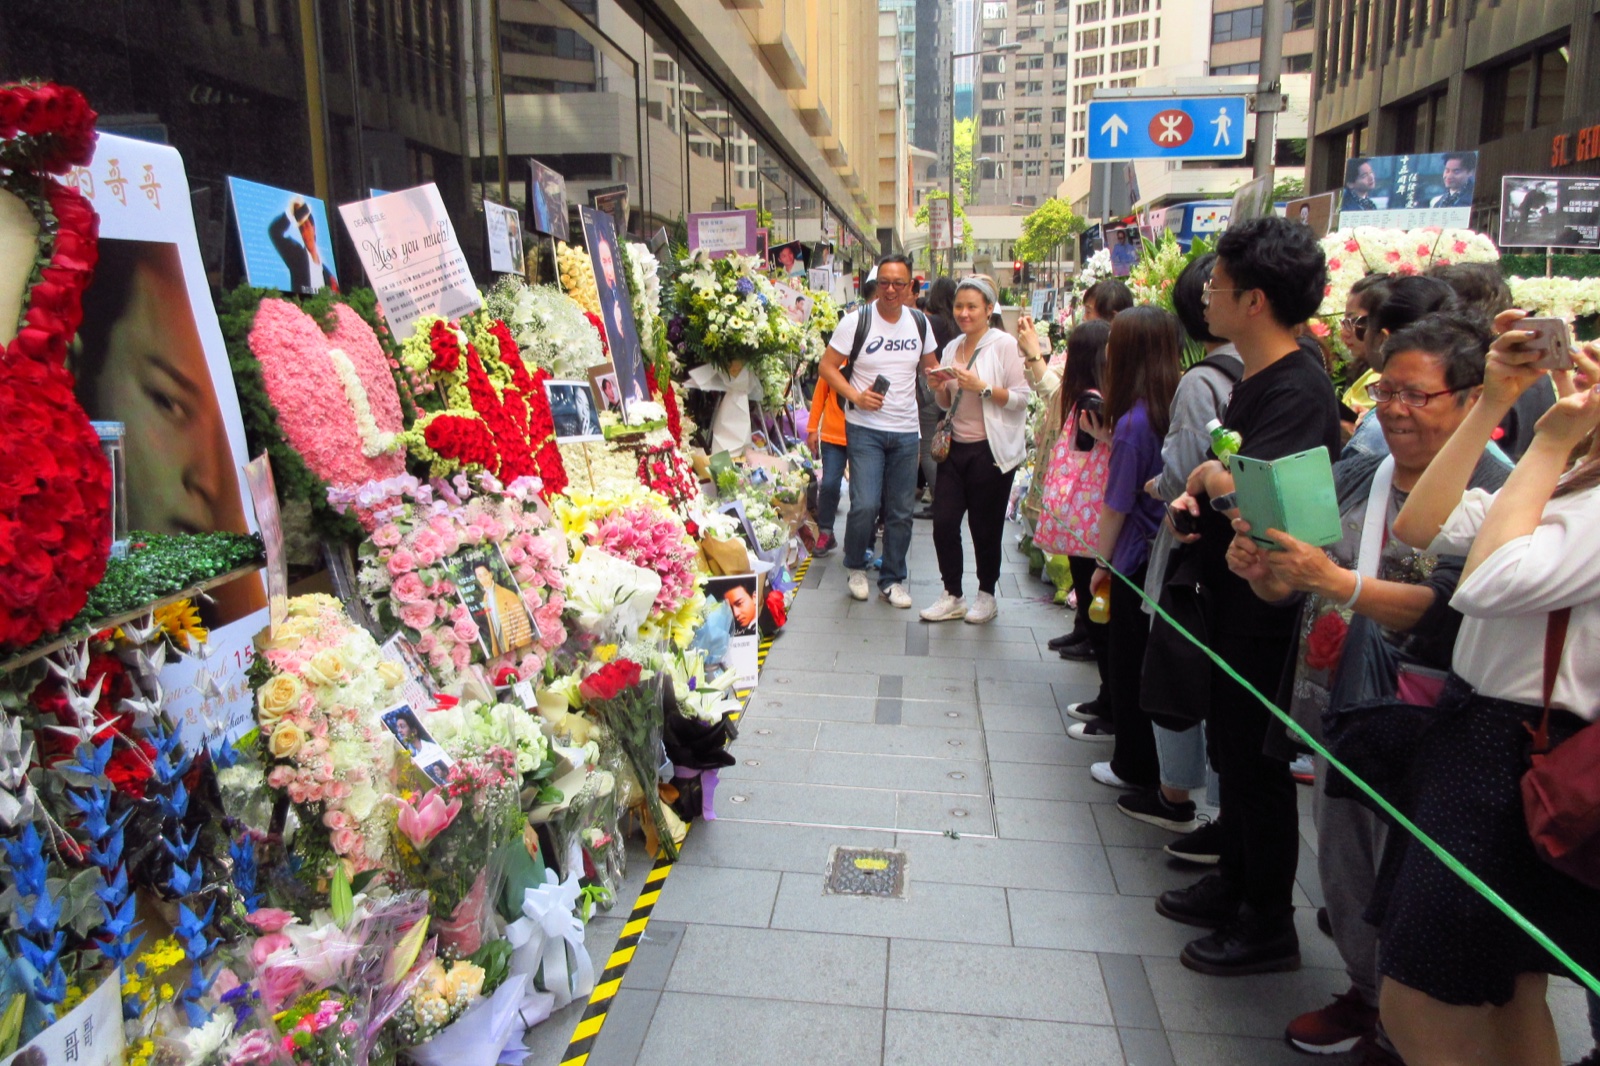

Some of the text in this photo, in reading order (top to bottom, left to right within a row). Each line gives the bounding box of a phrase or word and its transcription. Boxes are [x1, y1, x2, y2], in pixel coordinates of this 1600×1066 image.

[362, 238, 398, 272] Miss
[401, 239, 420, 264] you
[423, 218, 451, 249] much!
[448, 556, 463, 566] Dear
[234, 645, 254, 669] 15
[64, 1014, 94, 1063] 哥哥
